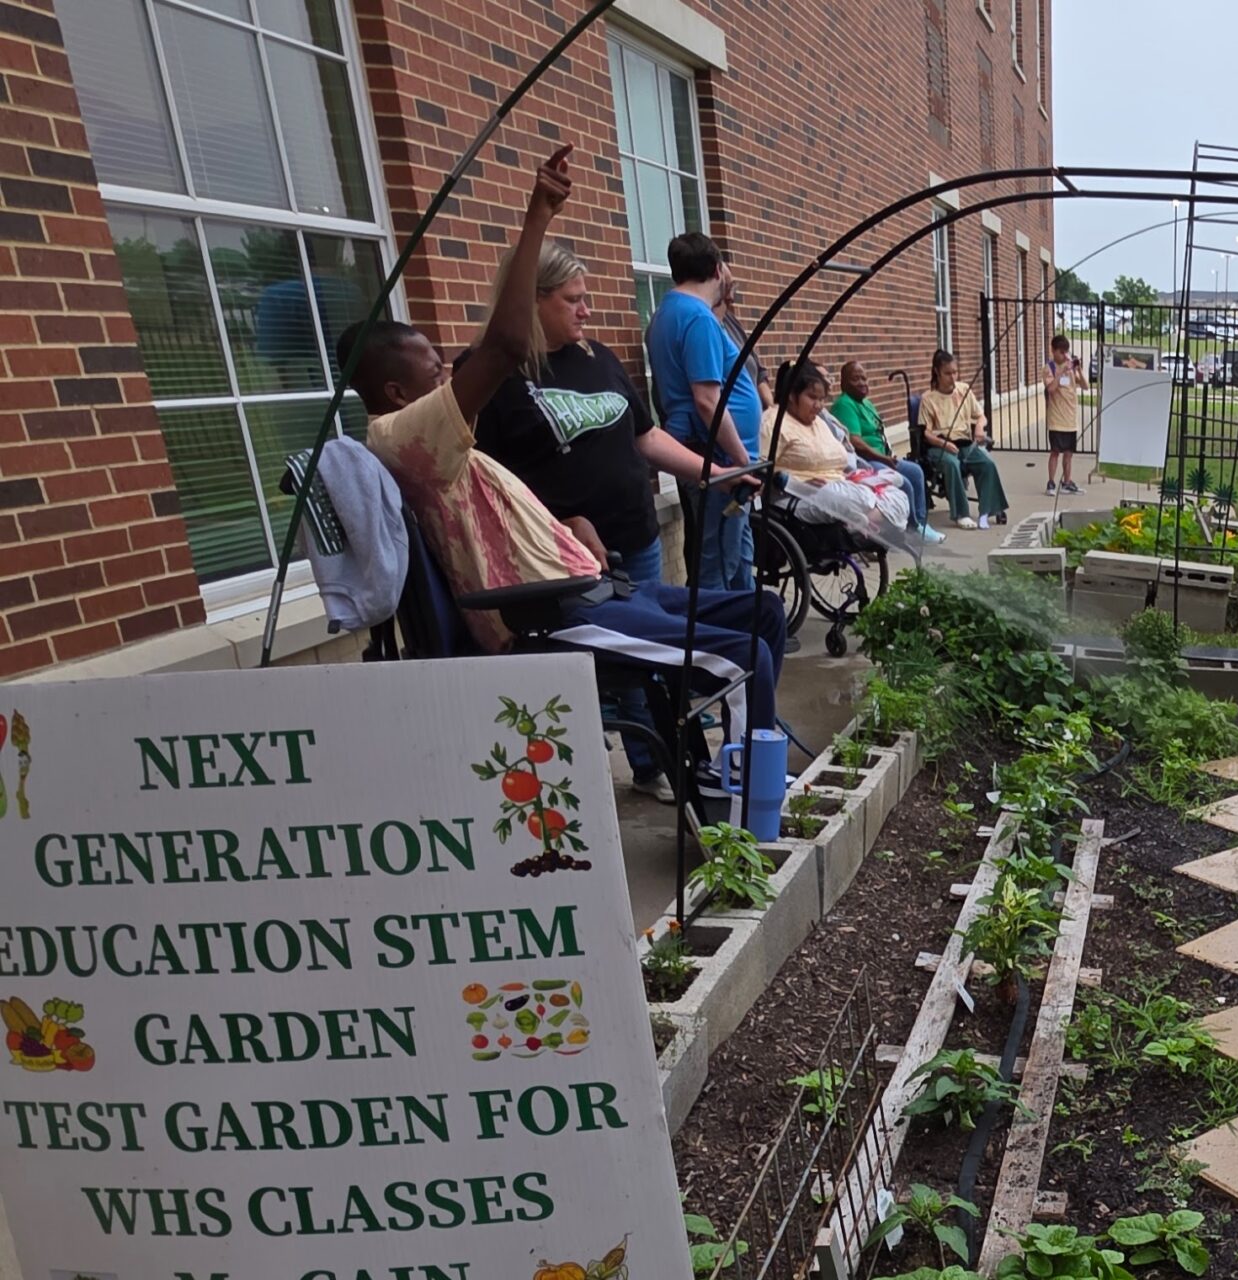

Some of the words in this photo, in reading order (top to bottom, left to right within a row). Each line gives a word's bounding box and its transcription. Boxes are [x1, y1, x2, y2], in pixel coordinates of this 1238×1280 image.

[135, 729, 315, 790] NEXT
[34, 817, 476, 888] GENERATION
[0, 918, 353, 977] EDUCATION
[373, 905, 586, 968] STEM
[134, 1006, 417, 1065] GARDEN
[4, 1101, 146, 1152] TEST
[164, 1093, 448, 1152] GARDEN
[469, 1081, 628, 1140] FOR
[82, 1187, 232, 1237] WHS
[248, 1171, 555, 1237] CLASSES
